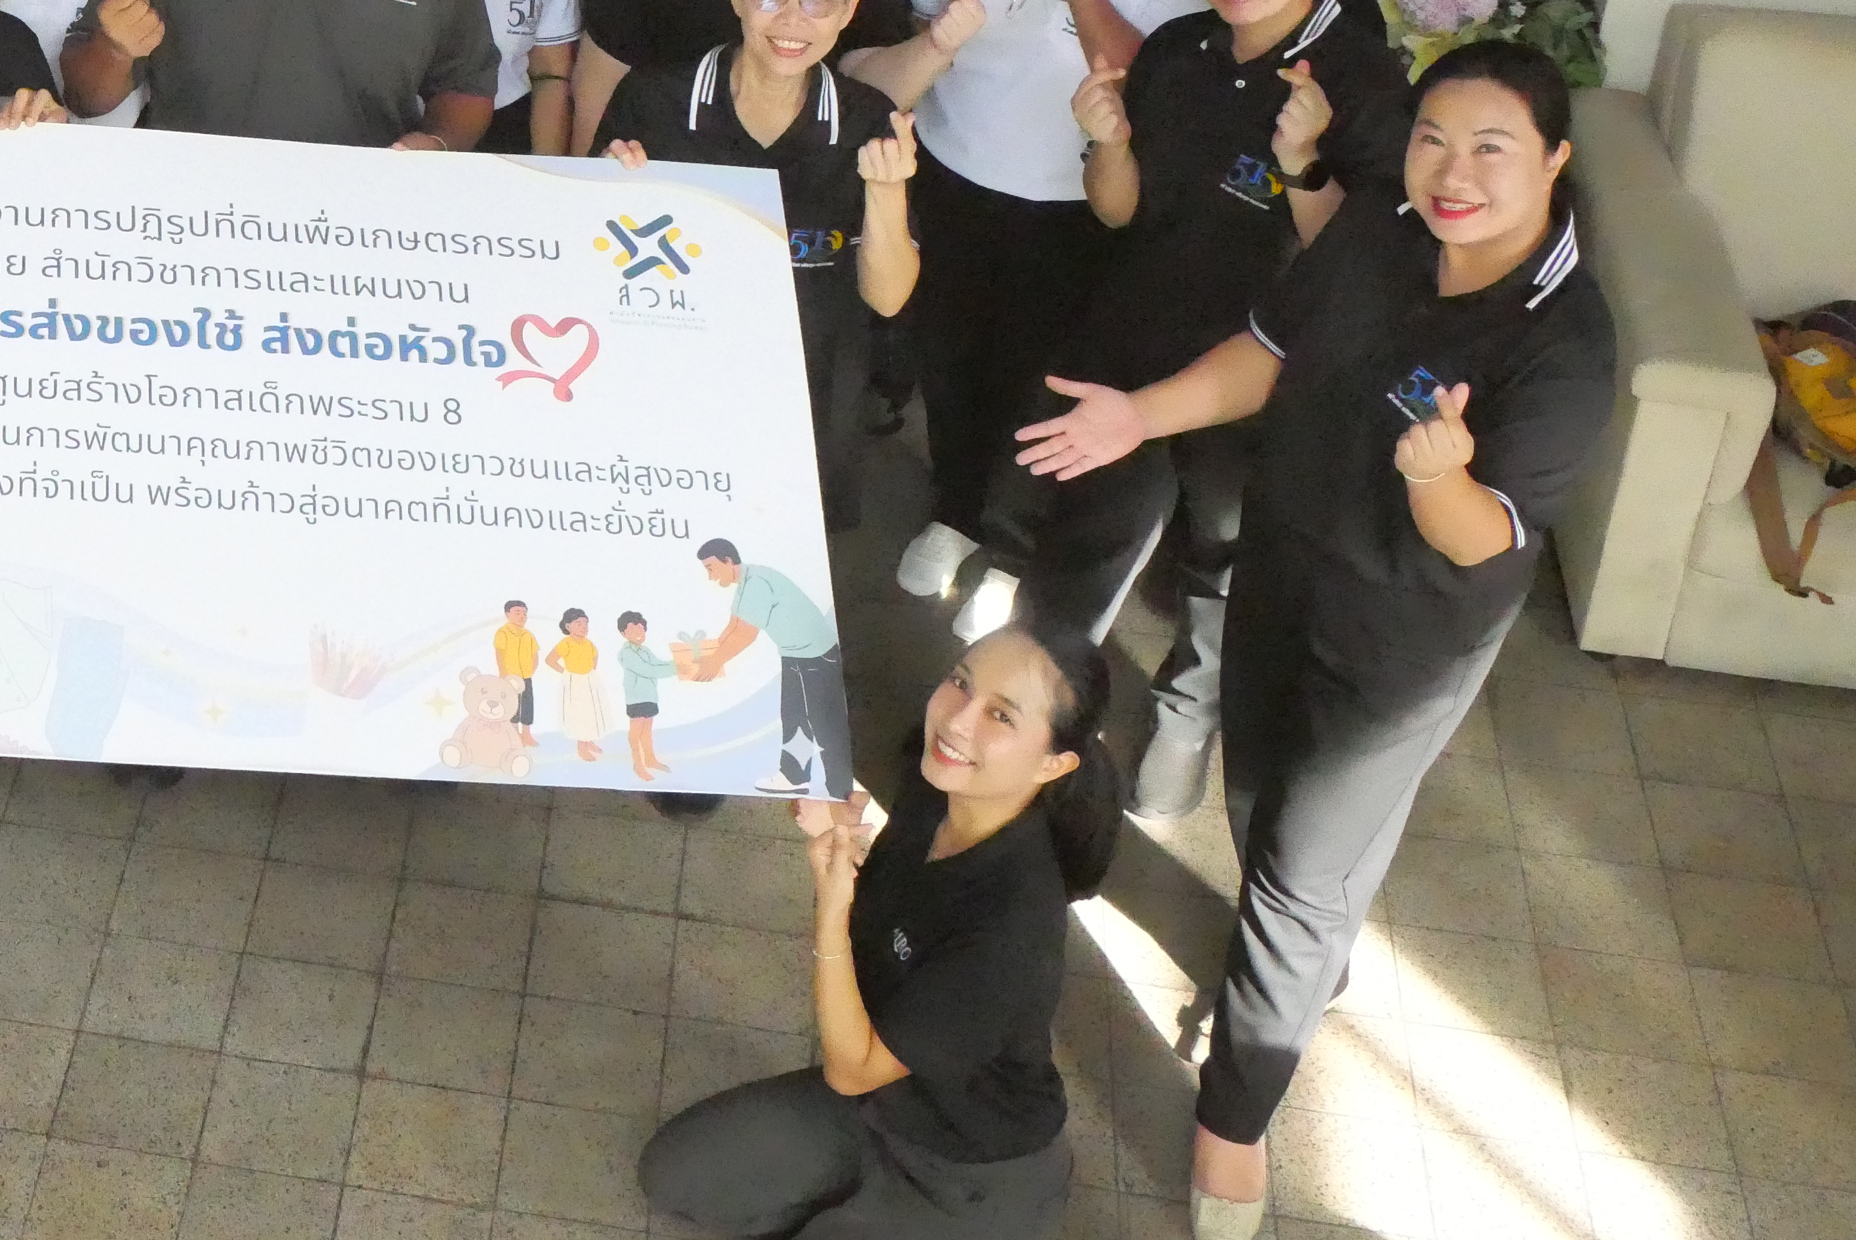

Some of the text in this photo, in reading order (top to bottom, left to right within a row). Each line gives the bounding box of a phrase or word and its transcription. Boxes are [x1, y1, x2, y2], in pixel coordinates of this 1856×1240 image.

[791, 229, 826, 259] 51
[41, 247, 470, 304] สำนักวิชาการและแผนงาน
[260, 311, 508, 368] ส่งต่อหัวใจ
[442, 397, 464, 426] 8
[147, 475, 690, 540] พร้อมก้าวสู่อนาคตที่มั่นคงและยั่งยืน
